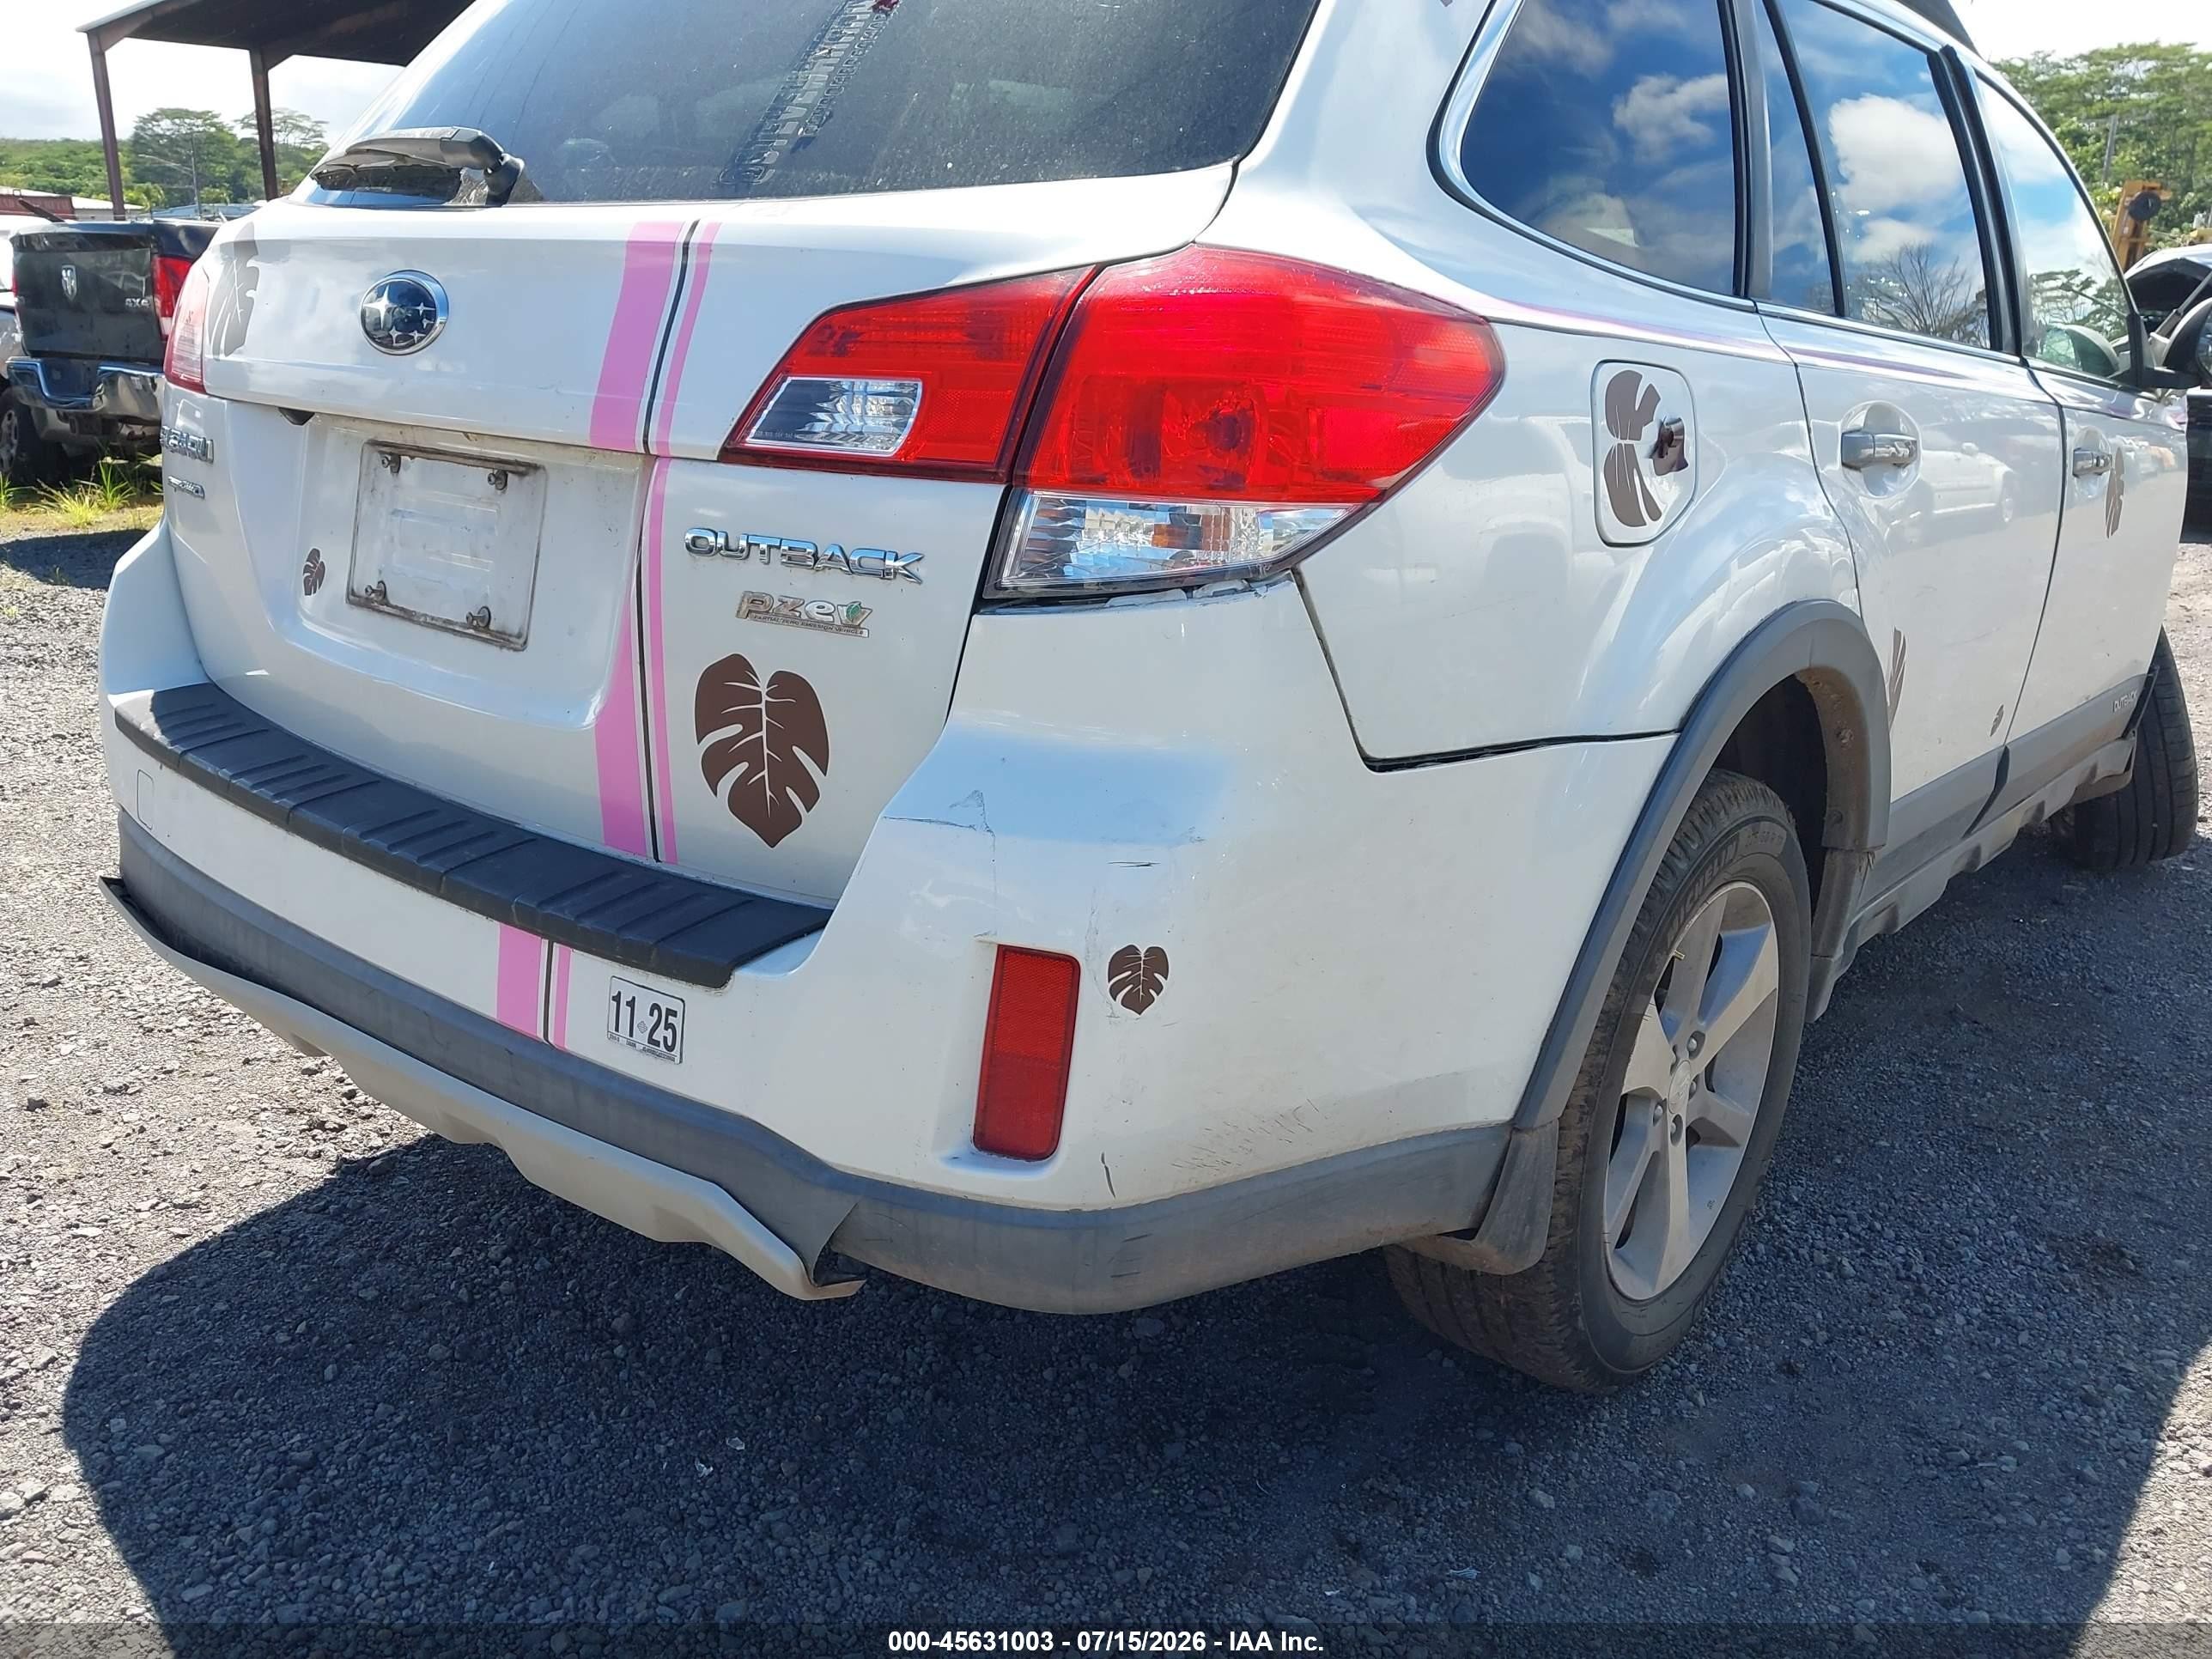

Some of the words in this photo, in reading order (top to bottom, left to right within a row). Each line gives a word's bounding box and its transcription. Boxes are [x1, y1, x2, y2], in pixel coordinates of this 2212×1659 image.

[684, 527, 925, 585] OUTBACK
[611, 990, 636, 1038] 11
[647, 1002, 678, 1053] 25
